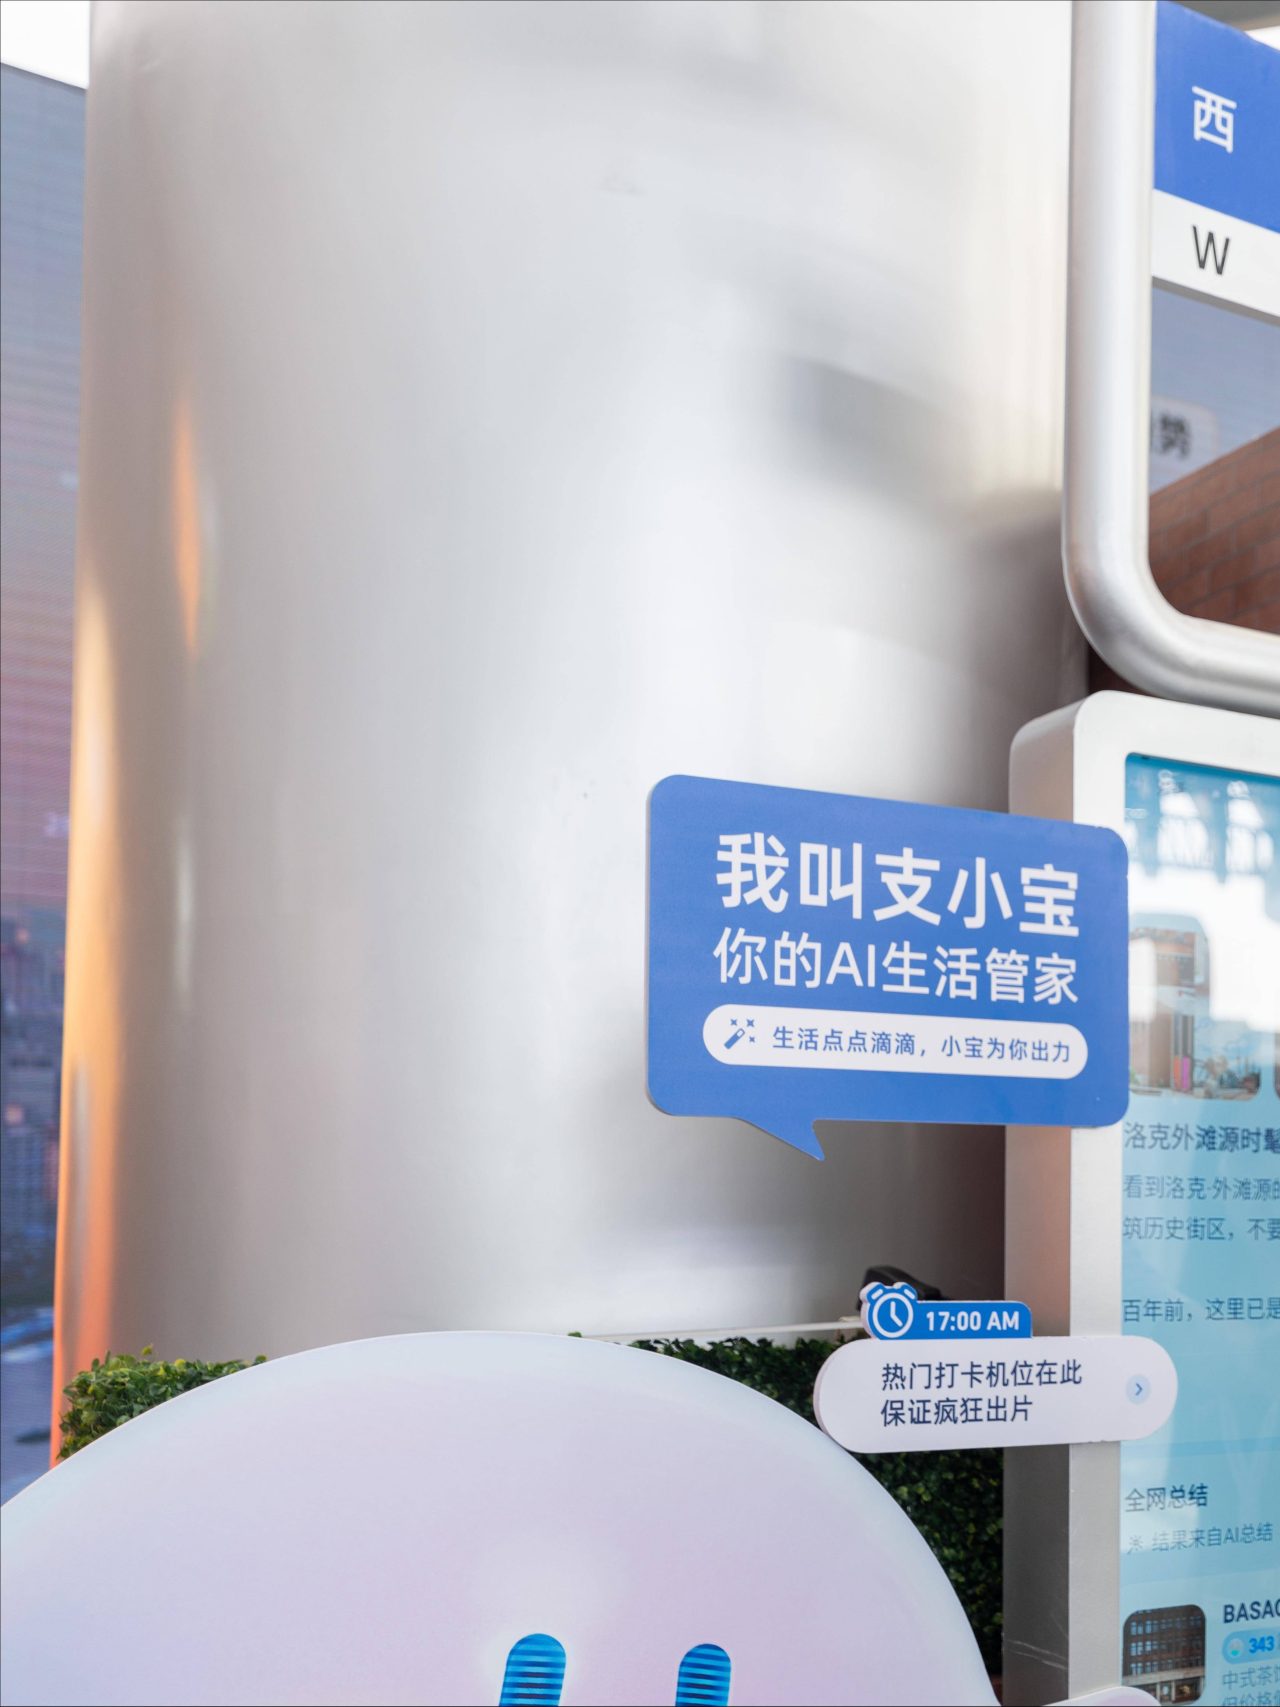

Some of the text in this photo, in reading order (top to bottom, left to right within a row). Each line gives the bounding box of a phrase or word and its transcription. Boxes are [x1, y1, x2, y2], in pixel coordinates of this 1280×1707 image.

[1192, 86, 1237, 153] 西
[1192, 225, 1230, 276] W
[715, 831, 1080, 938] 我叫支小宝
[713, 927, 1079, 1006] 你的AI生活管家
[772, 1026, 1071, 1064] 生活点点滴滴，小宝为你出力
[926, 1311, 1020, 1332] 17:00 AM
[881, 1359, 1083, 1391] 热门打卡机位在此
[880, 1395, 1033, 1427] 保证疯狂出片
[1125, 1483, 1209, 1512] 全网总结
[1152, 1522, 1273, 1552] 结果来自AI总结
